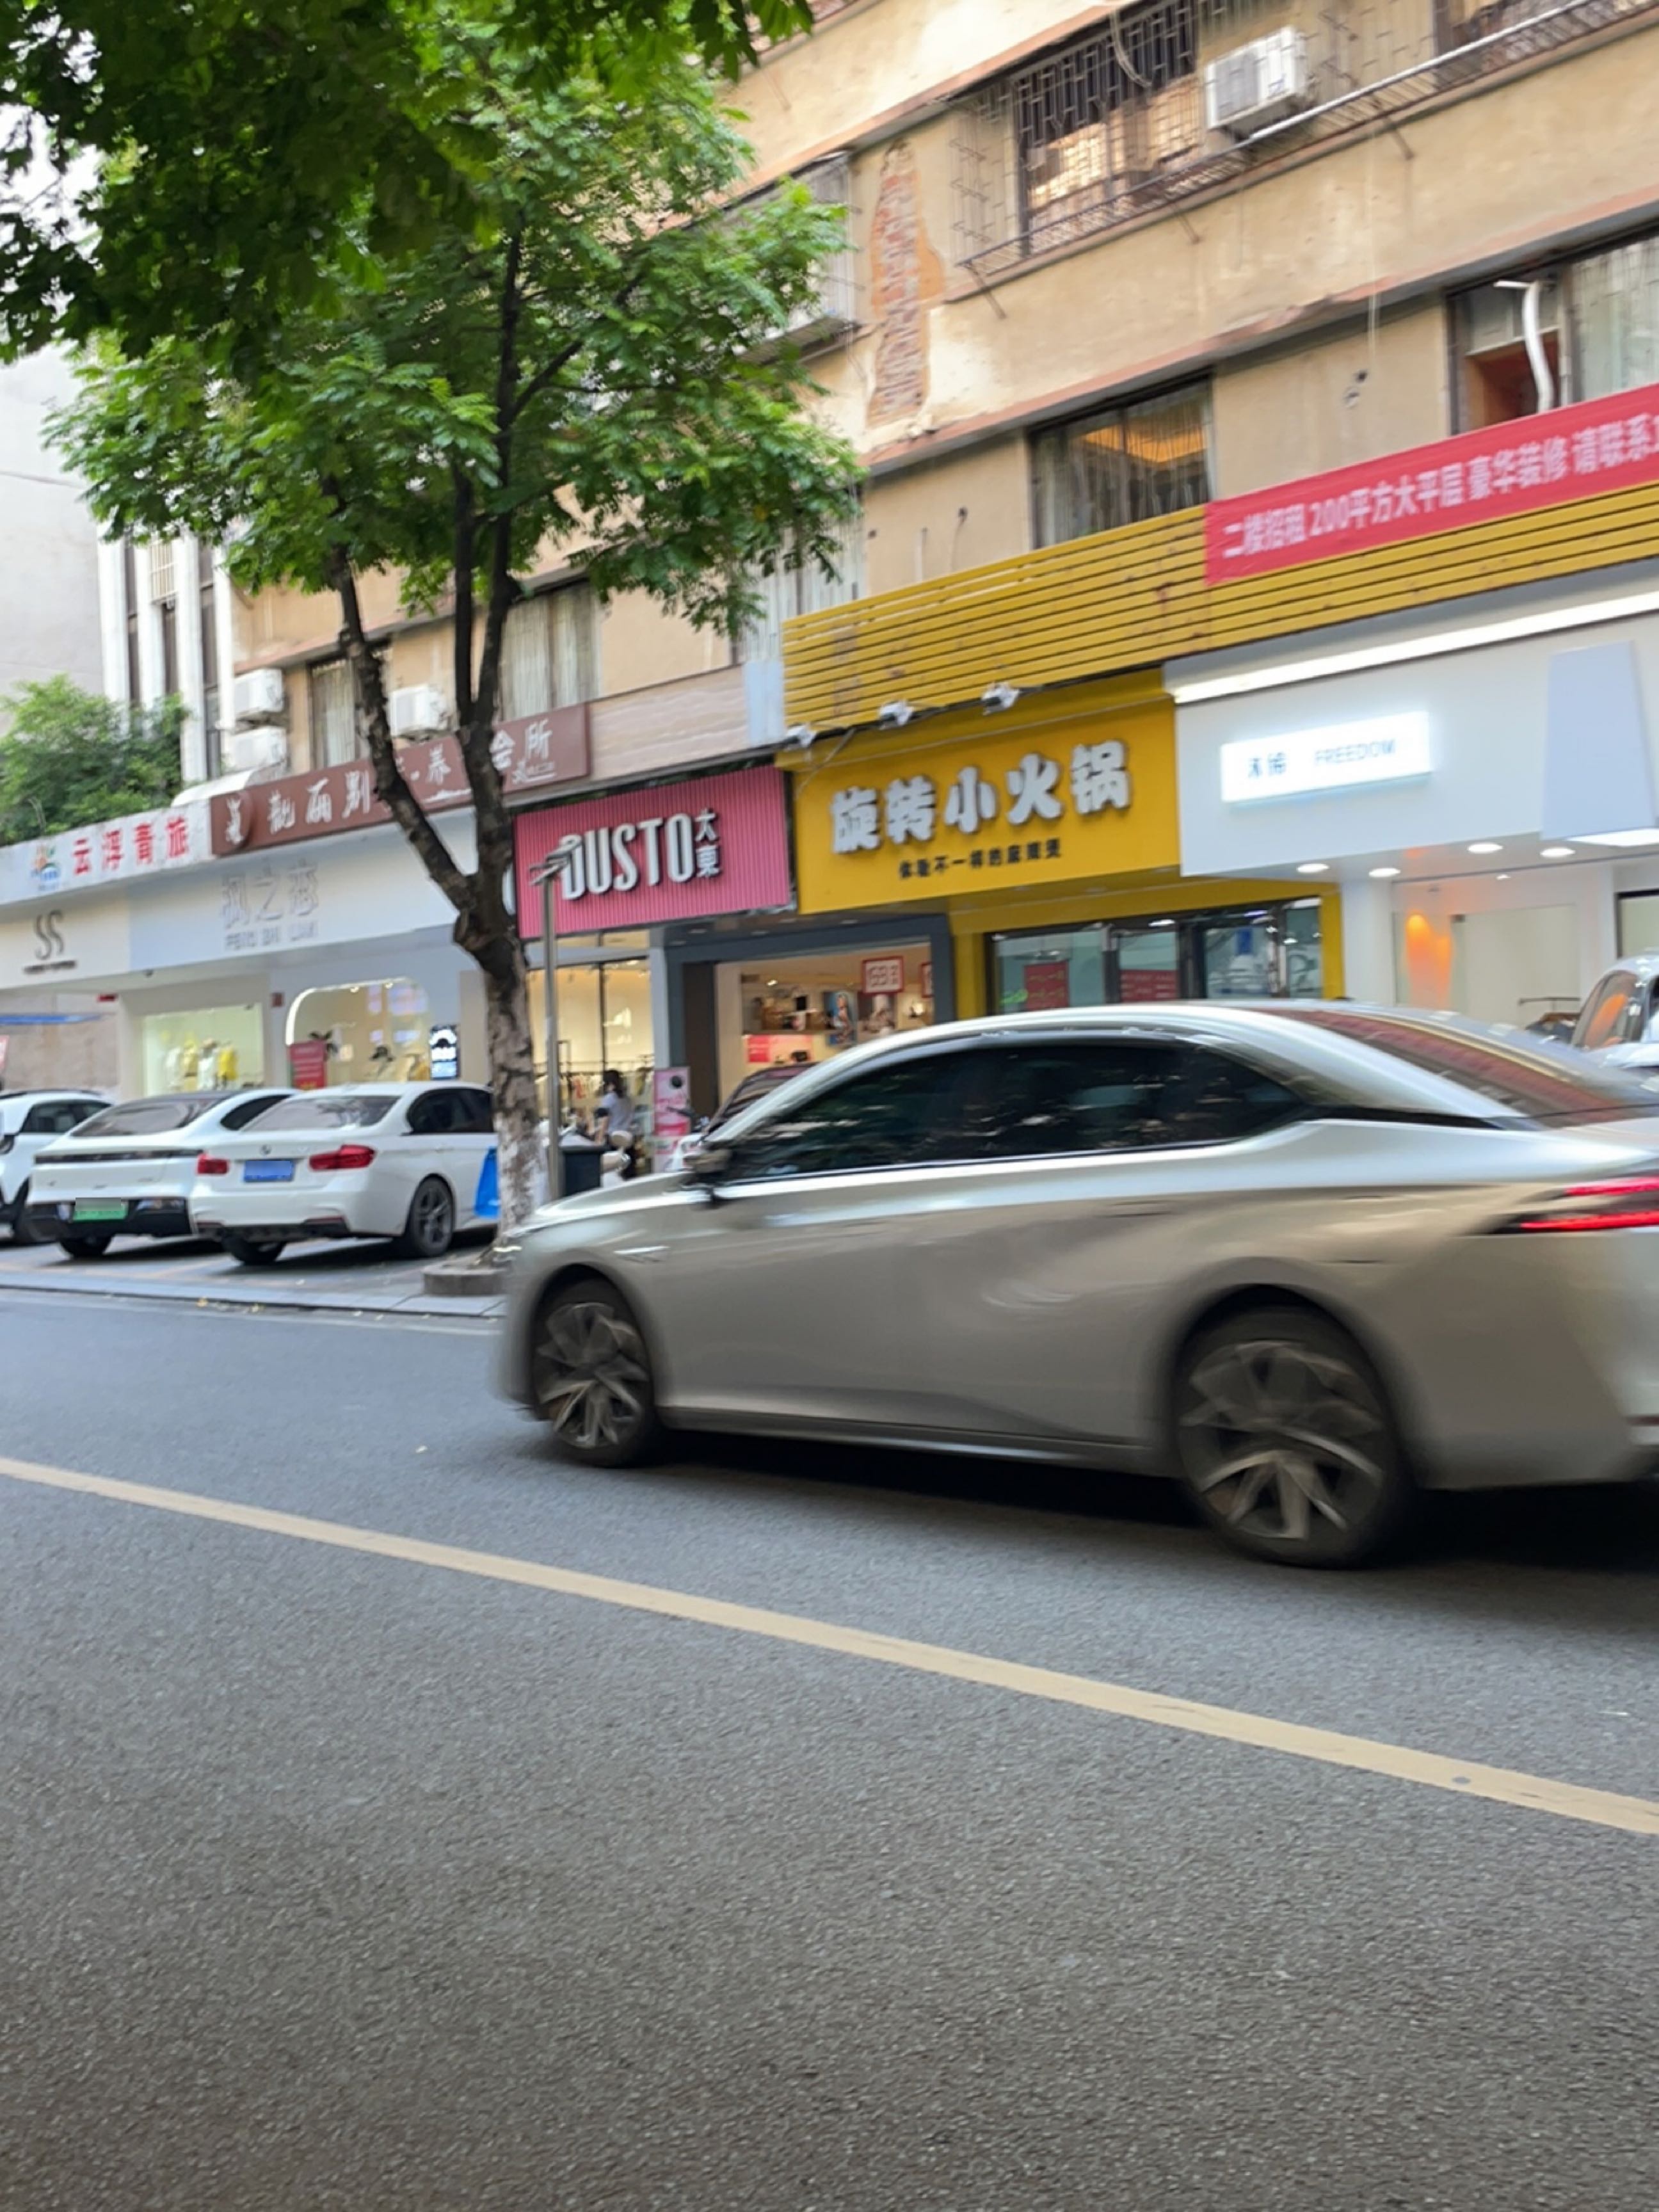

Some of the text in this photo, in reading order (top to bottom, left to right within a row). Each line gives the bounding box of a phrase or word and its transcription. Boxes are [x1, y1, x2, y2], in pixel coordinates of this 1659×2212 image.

[1310, 462, 1463, 537] 200平方大平层
[1572, 413, 1659, 475] 请联系
[1315, 739, 1396, 765] FREEDOM
[830, 739, 1132, 854] 旋转小火锅
[72, 815, 189, 876] 云浮青旅
[559, 813, 694, 901] DUSTO
